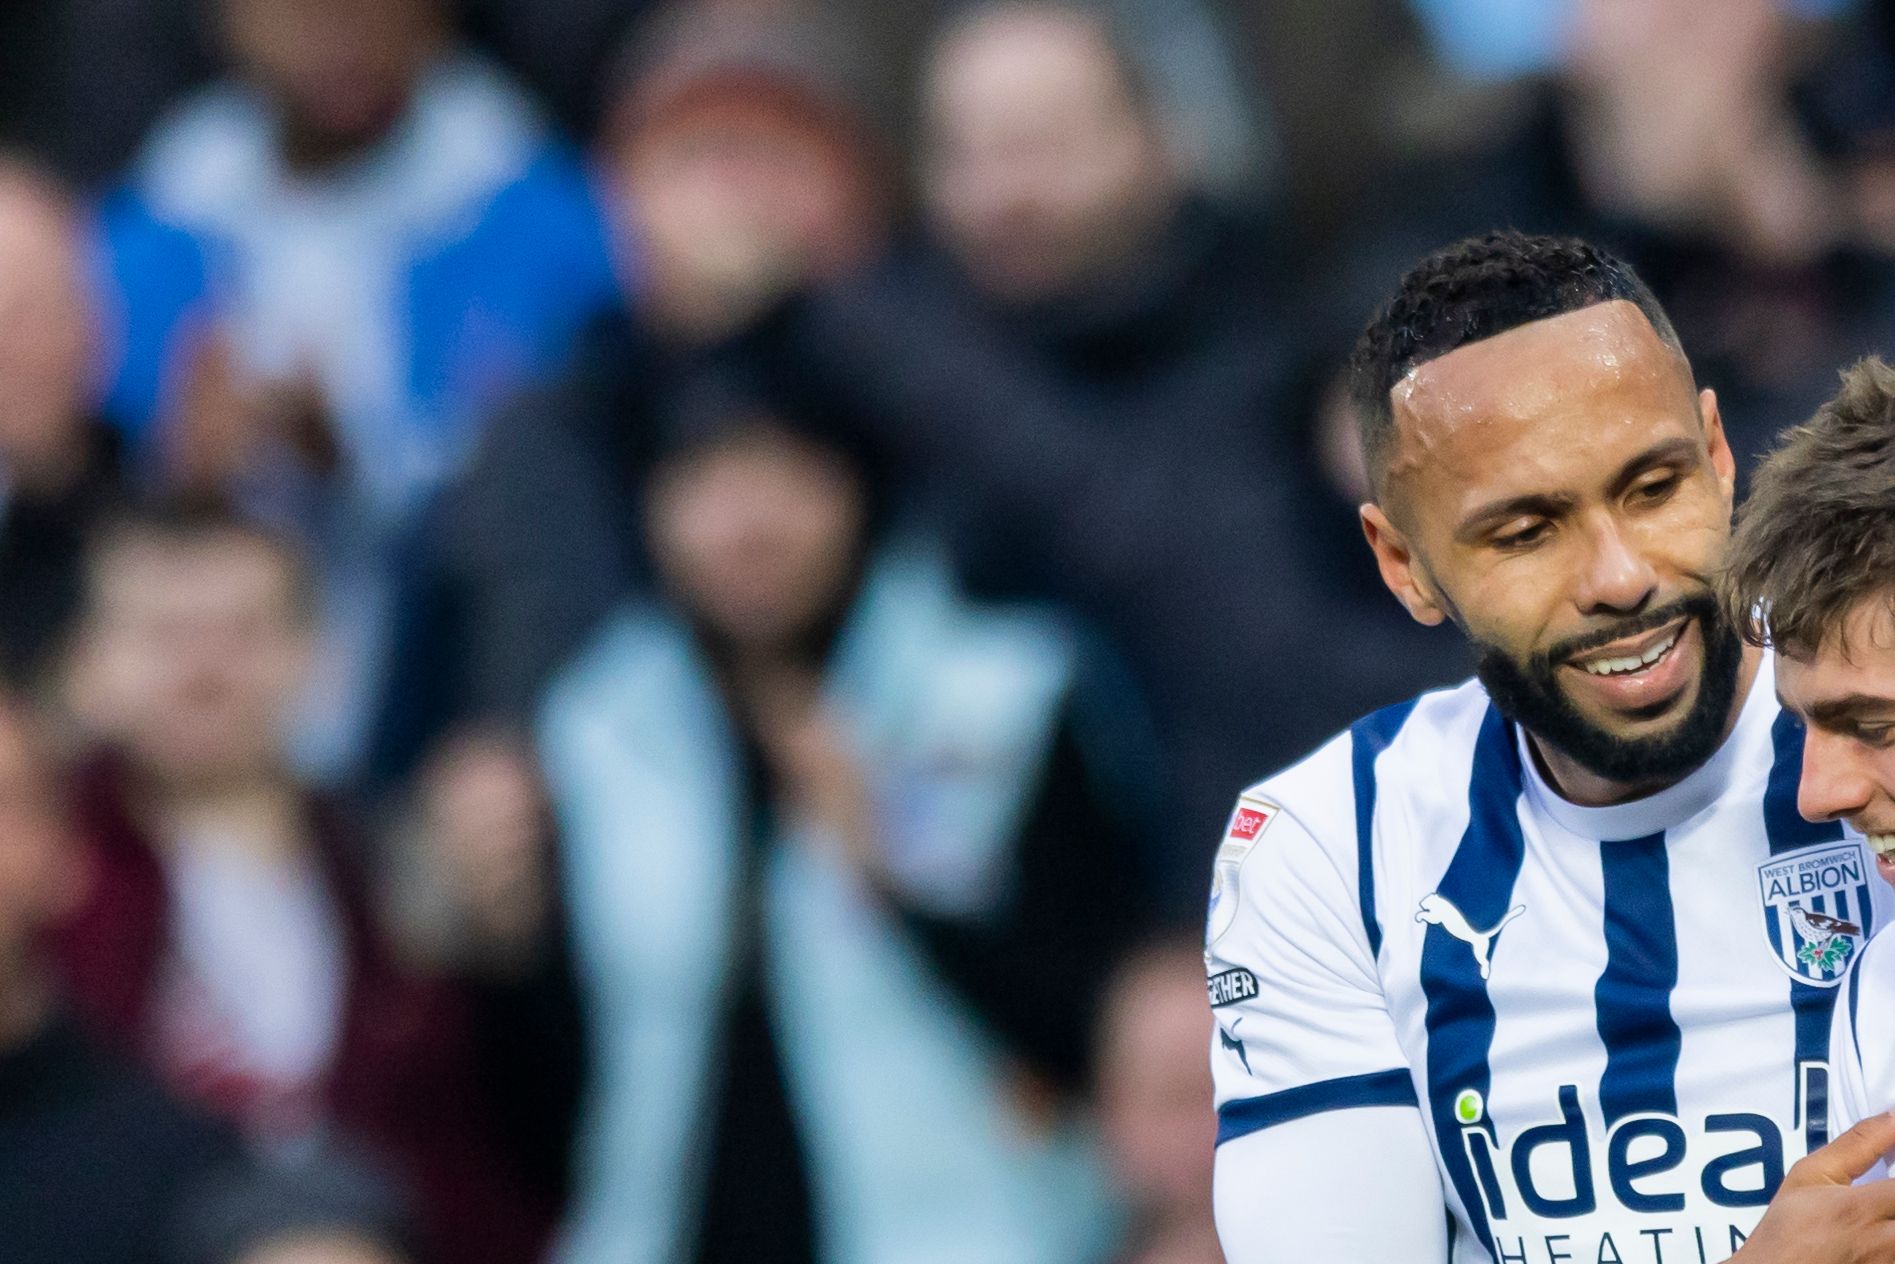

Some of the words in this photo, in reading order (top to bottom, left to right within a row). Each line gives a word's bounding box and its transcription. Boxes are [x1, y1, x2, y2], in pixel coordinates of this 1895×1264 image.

[1764, 864, 1796, 879] WEST
[1798, 851, 1857, 872] BROMWICH
[1768, 860, 1860, 900] ALBION
[1458, 1066, 1829, 1220] ideal
